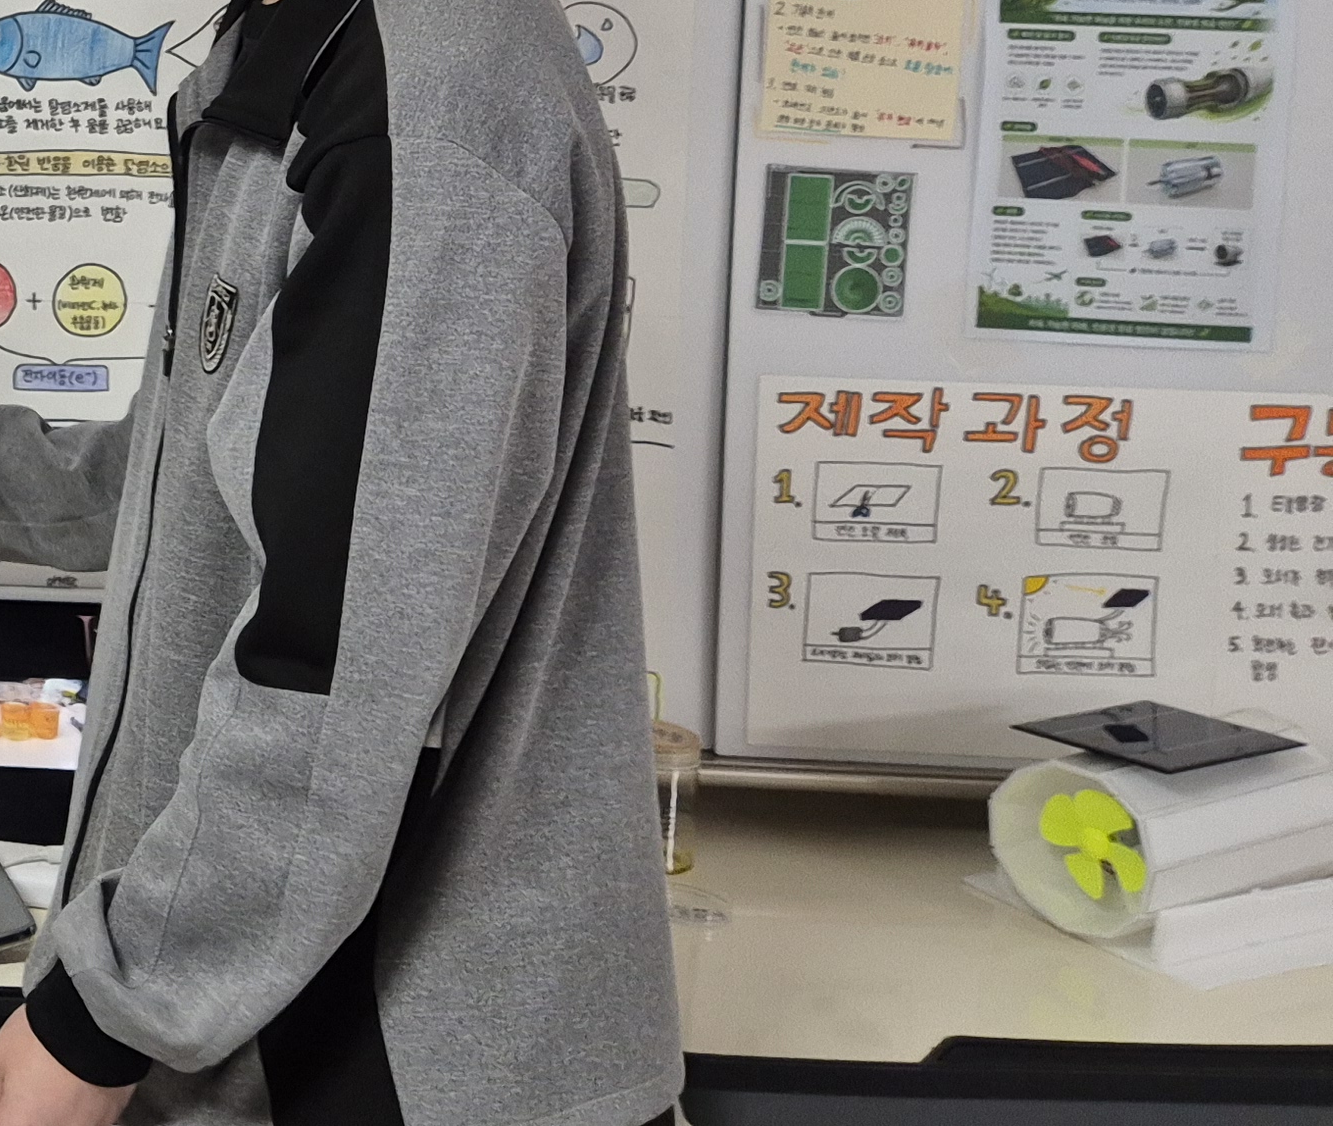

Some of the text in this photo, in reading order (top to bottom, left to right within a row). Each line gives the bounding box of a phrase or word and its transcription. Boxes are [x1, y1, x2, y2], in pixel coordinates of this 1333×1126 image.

[776, 387, 950, 454] 제작
[772, 468, 803, 509] 1.
[989, 469, 1032, 509] 2.
[767, 570, 796, 611] 3.
[975, 583, 1014, 620] 4.
